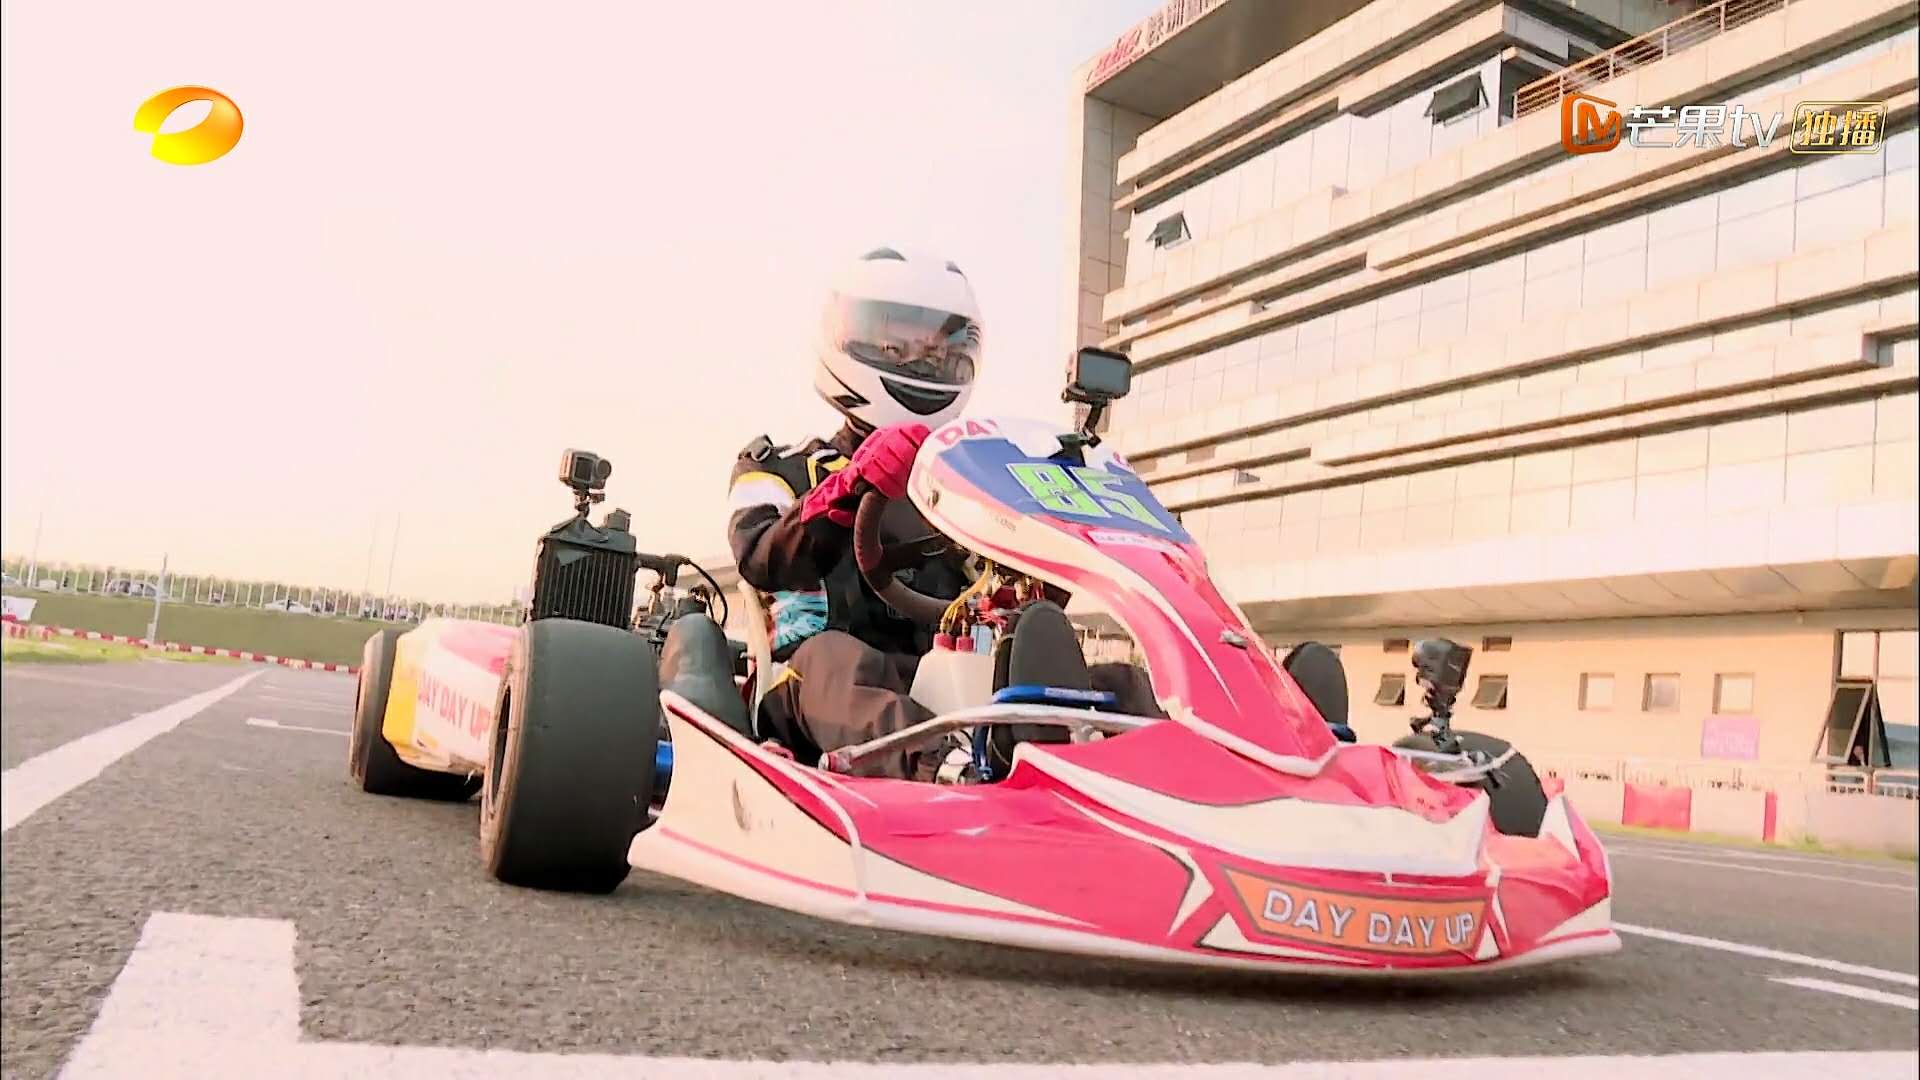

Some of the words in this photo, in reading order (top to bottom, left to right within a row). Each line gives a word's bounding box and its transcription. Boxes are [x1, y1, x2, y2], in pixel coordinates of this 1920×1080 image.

[1006, 463, 1172, 533] 85
[440, 685, 469, 729] DAY
[470, 700, 492, 742] UP
[1263, 889, 1354, 937] DAY
[1368, 912, 1435, 946] DAY
[1445, 912, 1475, 945] UP
